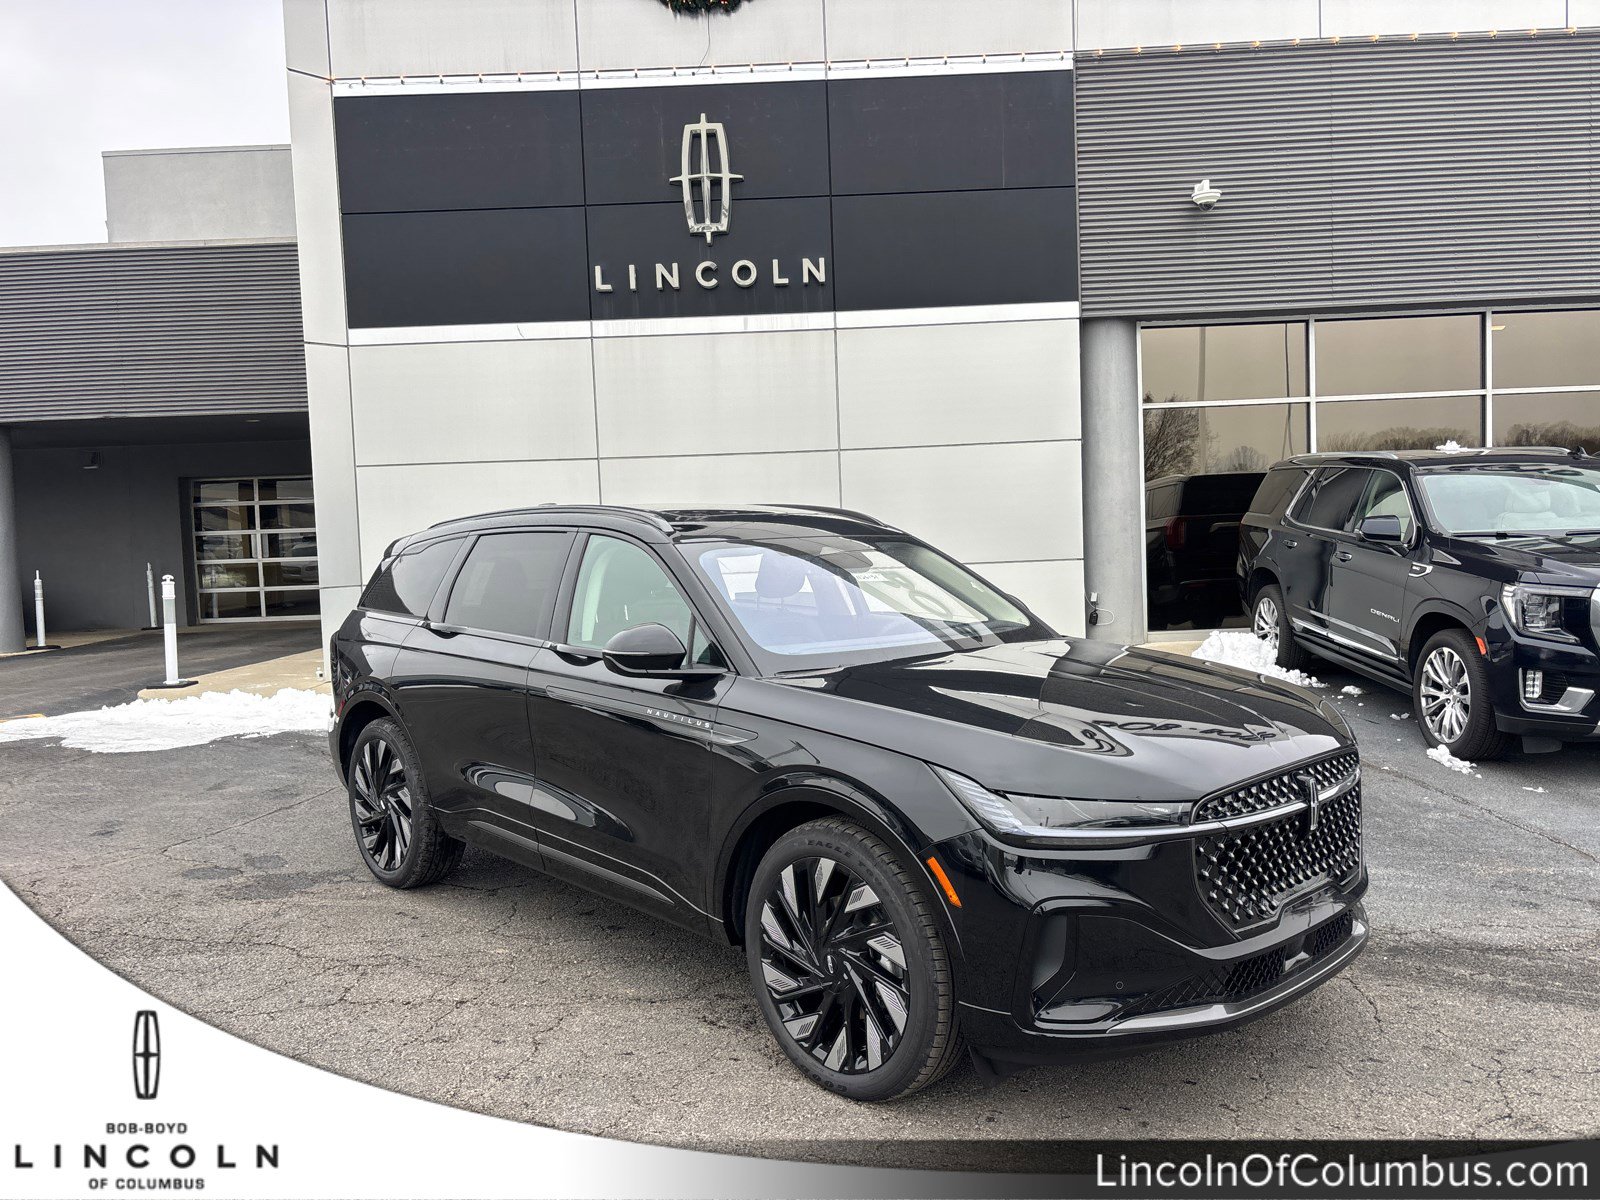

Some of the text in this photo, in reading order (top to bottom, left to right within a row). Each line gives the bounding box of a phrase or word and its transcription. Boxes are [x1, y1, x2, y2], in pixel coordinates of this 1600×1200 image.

[594, 257, 826, 292] LINCOLN
[1370, 608, 1400, 623] DENALI
[646, 709, 710, 728] NAUTILUS
